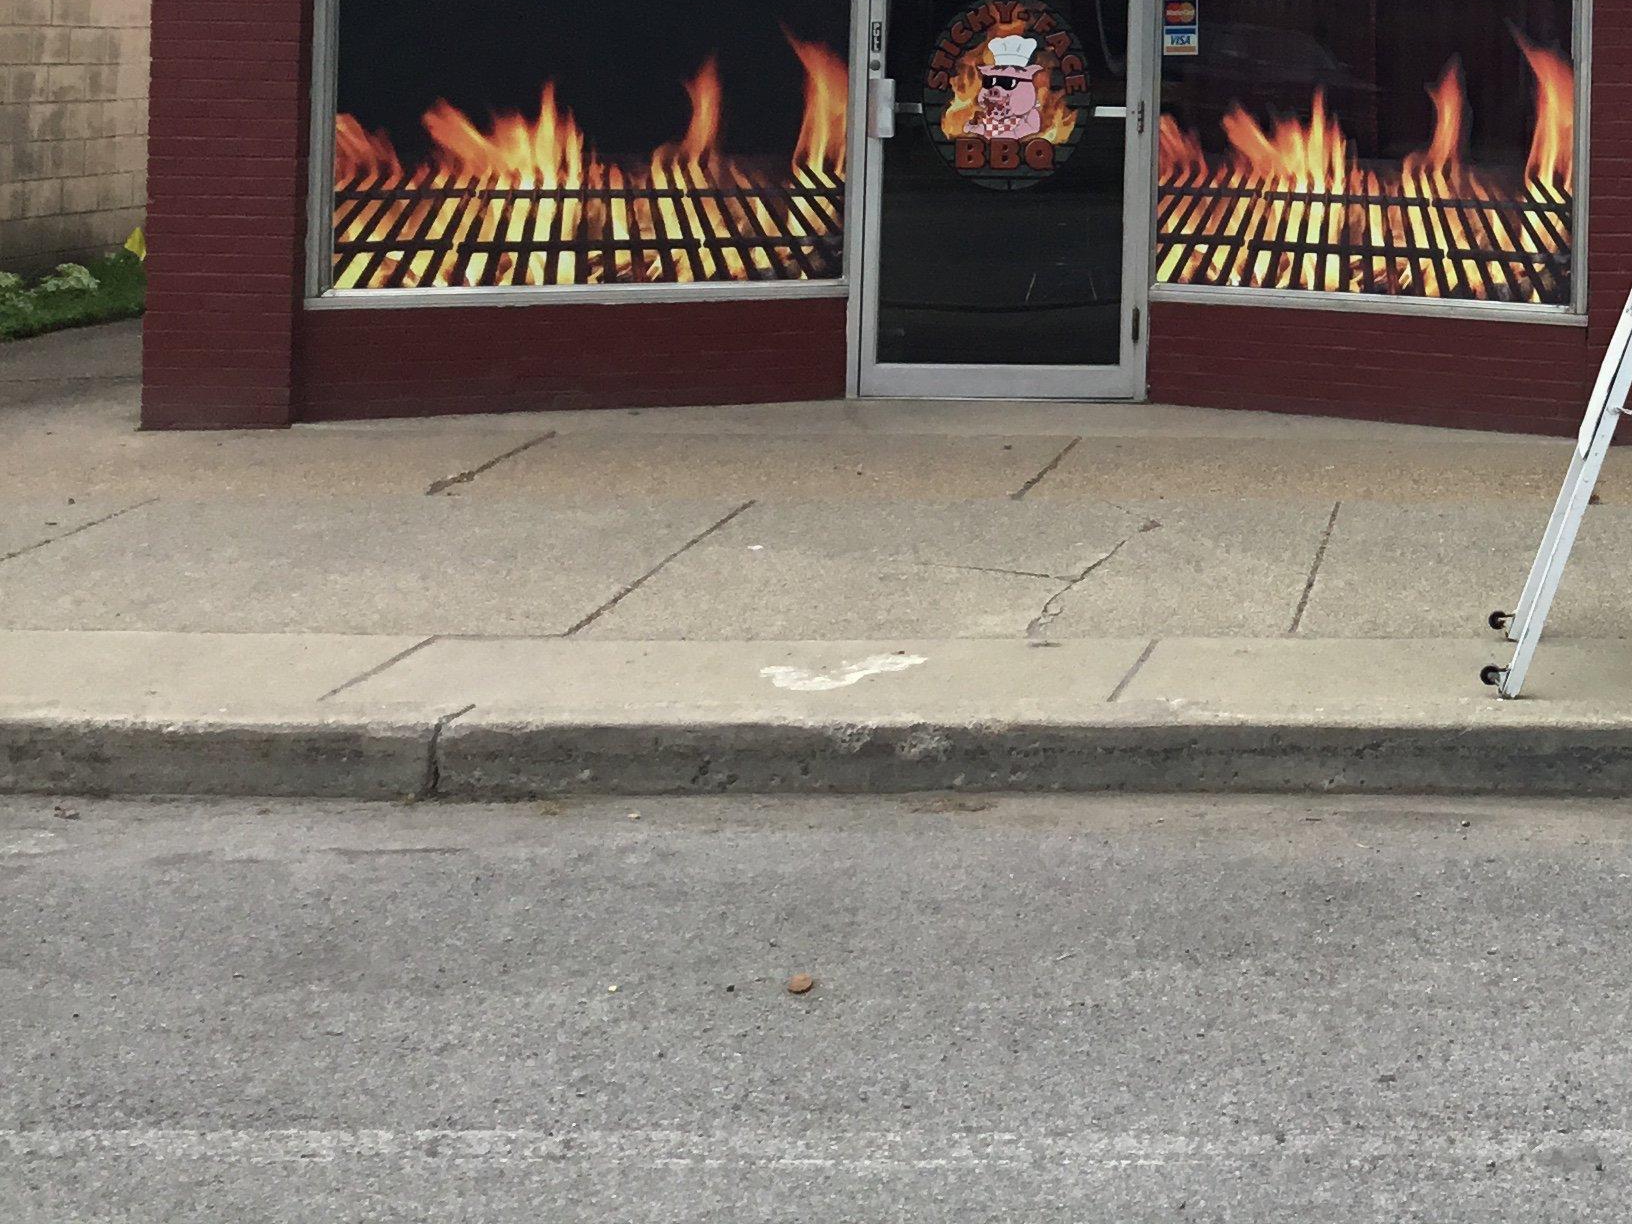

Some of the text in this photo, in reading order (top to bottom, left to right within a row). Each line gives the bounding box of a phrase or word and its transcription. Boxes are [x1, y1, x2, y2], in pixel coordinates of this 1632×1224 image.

[872, 22, 881, 51] PULL
[1171, 36, 1191, 45] VISA
[955, 138, 1055, 170] BBQ
